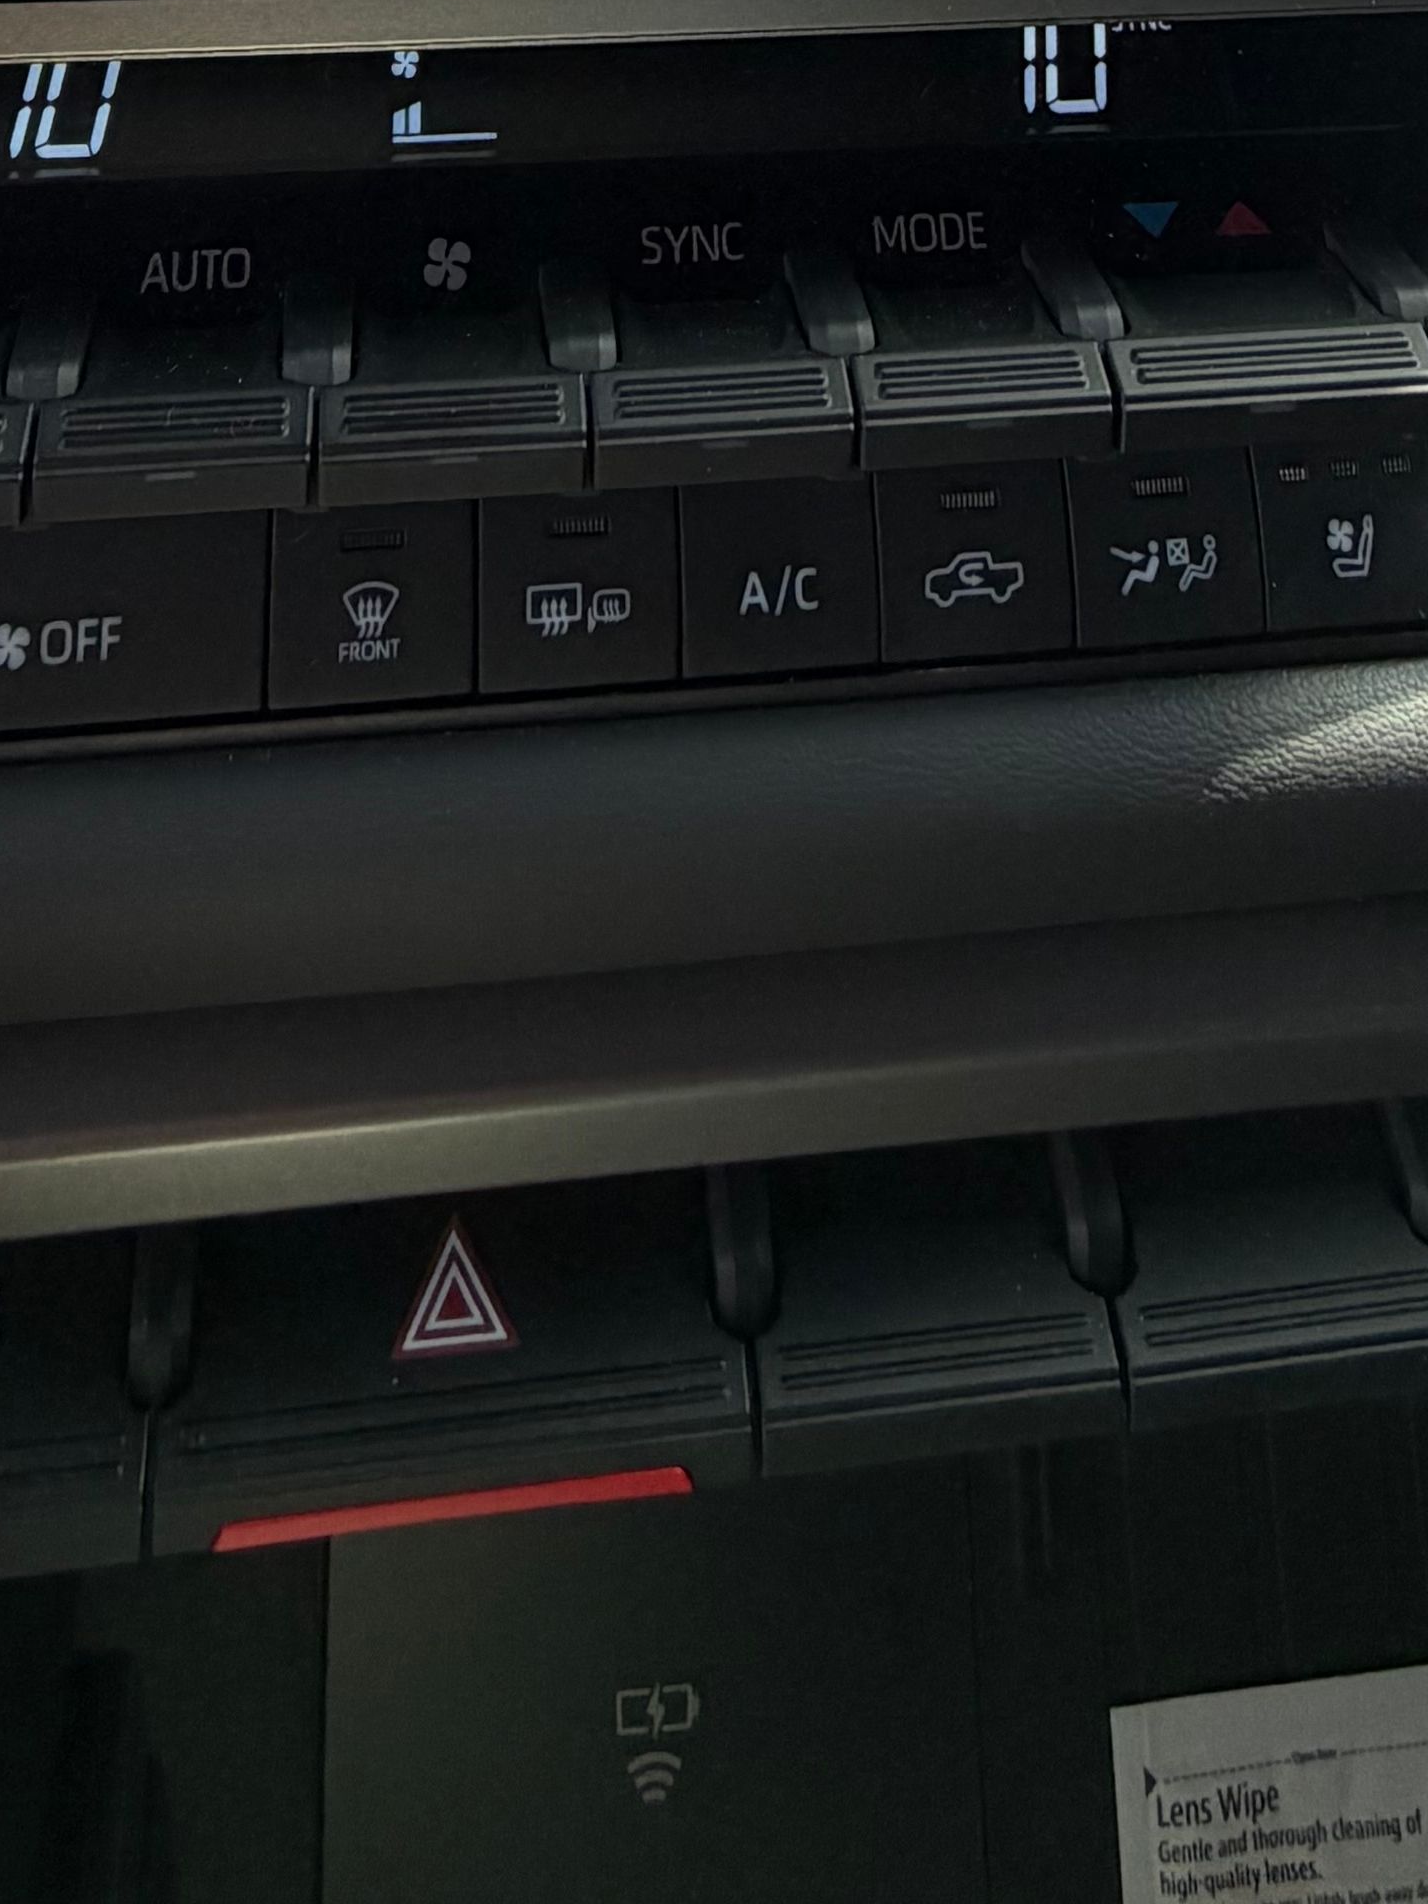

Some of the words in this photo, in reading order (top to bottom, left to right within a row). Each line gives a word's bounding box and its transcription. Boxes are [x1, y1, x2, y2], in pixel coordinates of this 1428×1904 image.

[641, 222, 744, 266] SYNC
[872, 212, 988, 254] MODE
[141, 247, 252, 294] AUTO
[740, 565, 820, 618] A/C
[40, 615, 123, 666] OFF
[338, 637, 401, 664] FRONT
[1157, 1794, 1212, 1829] Lens
[1217, 1782, 1280, 1823] Wipe
[1158, 1837, 1213, 1865] Gentle
[1218, 1830, 1247, 1858] and
[1252, 1819, 1328, 1851] thorough
[1332, 1813, 1402, 1845] cleaning
[1406, 1808, 1423, 1836] of
[1160, 1859, 1260, 1902] high-quality
[1263, 1858, 1323, 1884] lenses.
